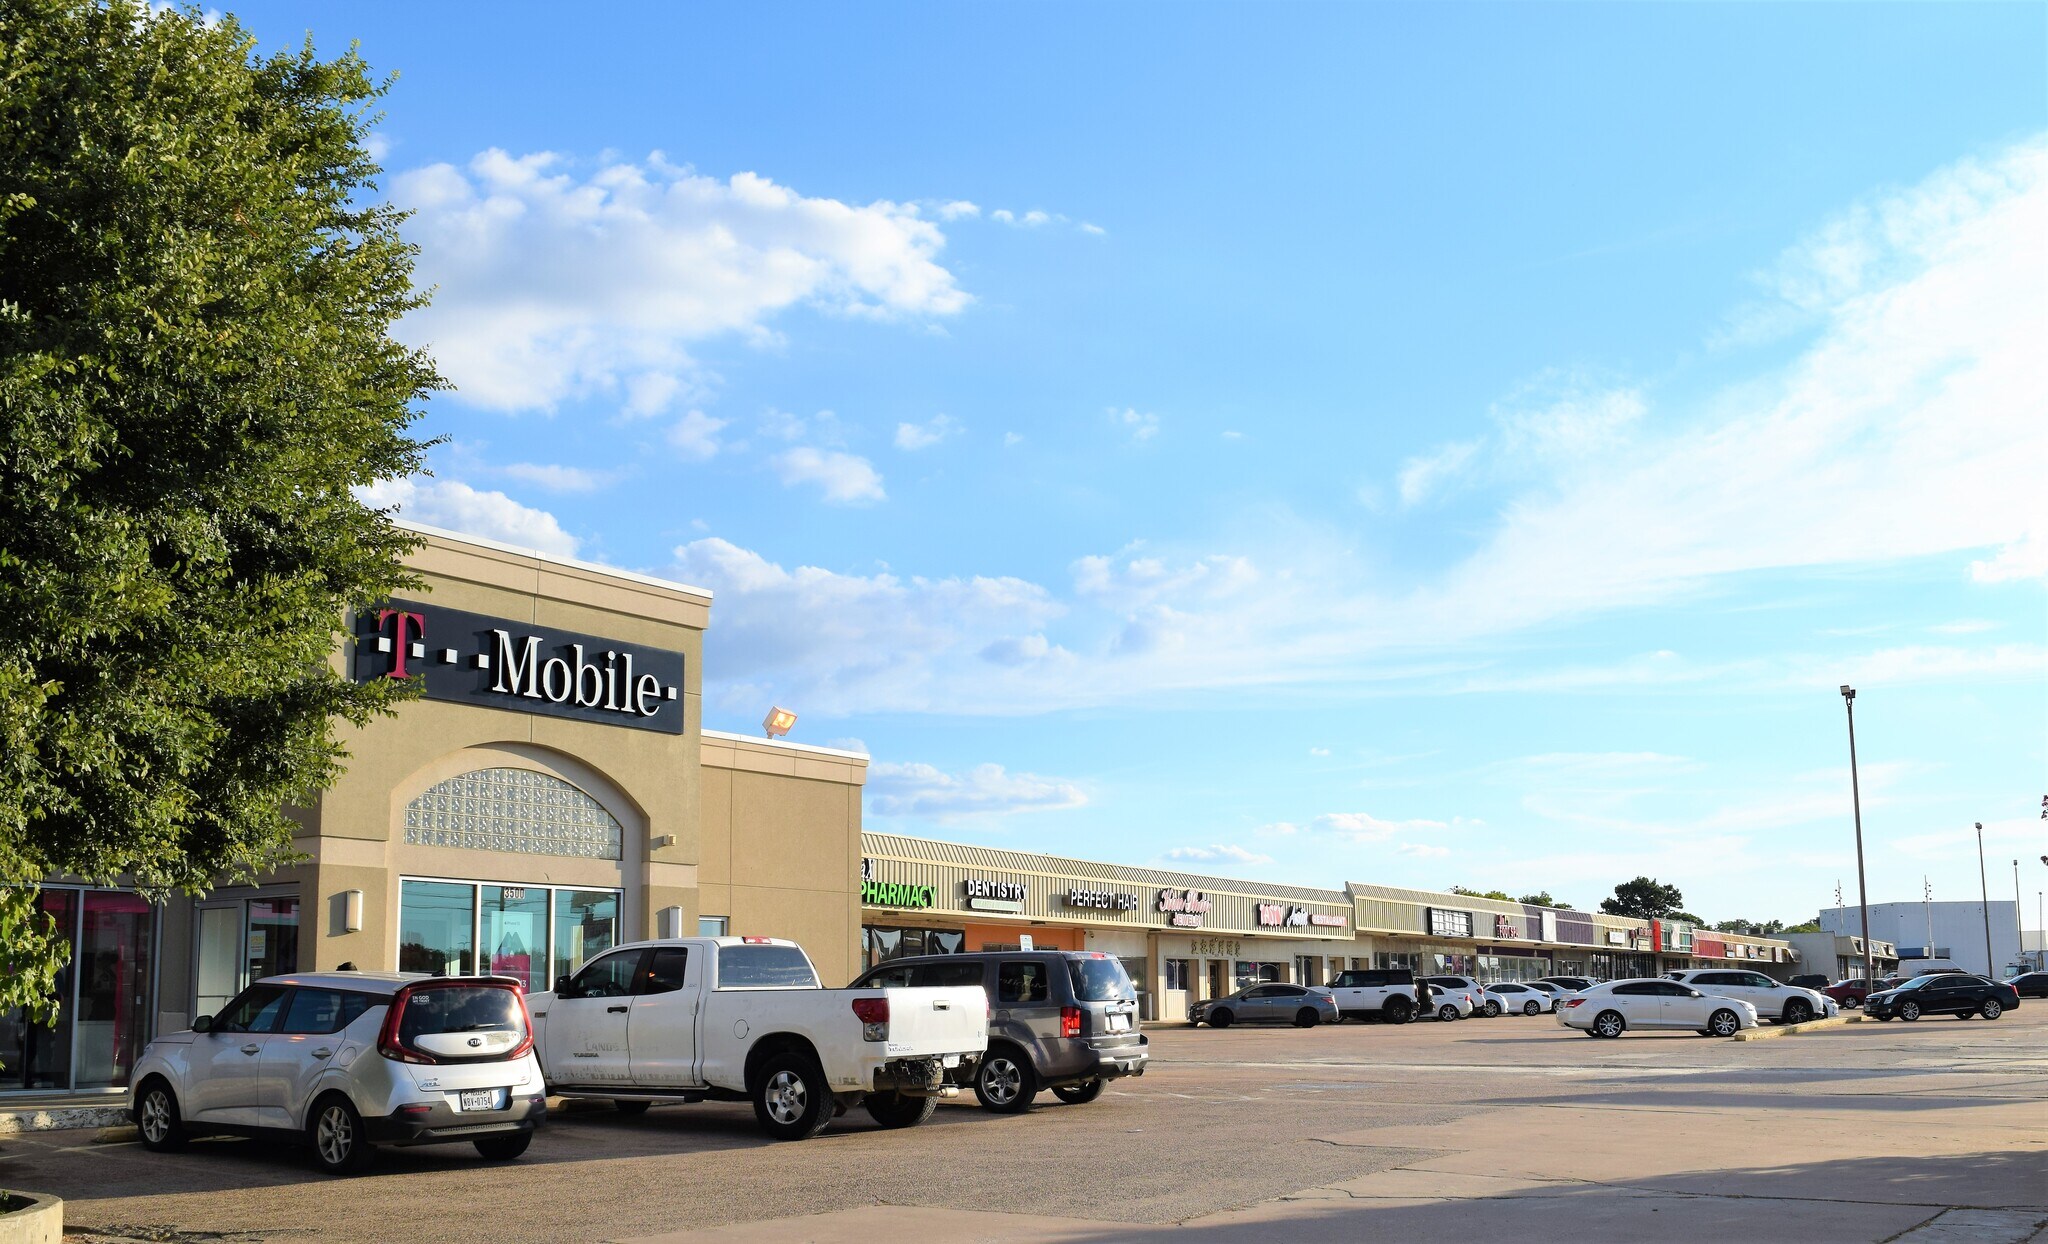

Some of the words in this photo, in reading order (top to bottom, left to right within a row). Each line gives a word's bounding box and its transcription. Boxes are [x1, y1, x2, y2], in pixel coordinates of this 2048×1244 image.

[491, 628, 662, 717] Mobile
[503, 887, 525, 899] 3500
[861, 881, 938, 908] PHARMACY
[967, 879, 1029, 900] DENTISTRY
[1070, 888, 1114, 909] PERFECT
[1117, 892, 1139, 911] HAIR
[1172, 912, 1203, 928] JEWELRY
[1313, 915, 1346, 926] RESTAURANT
